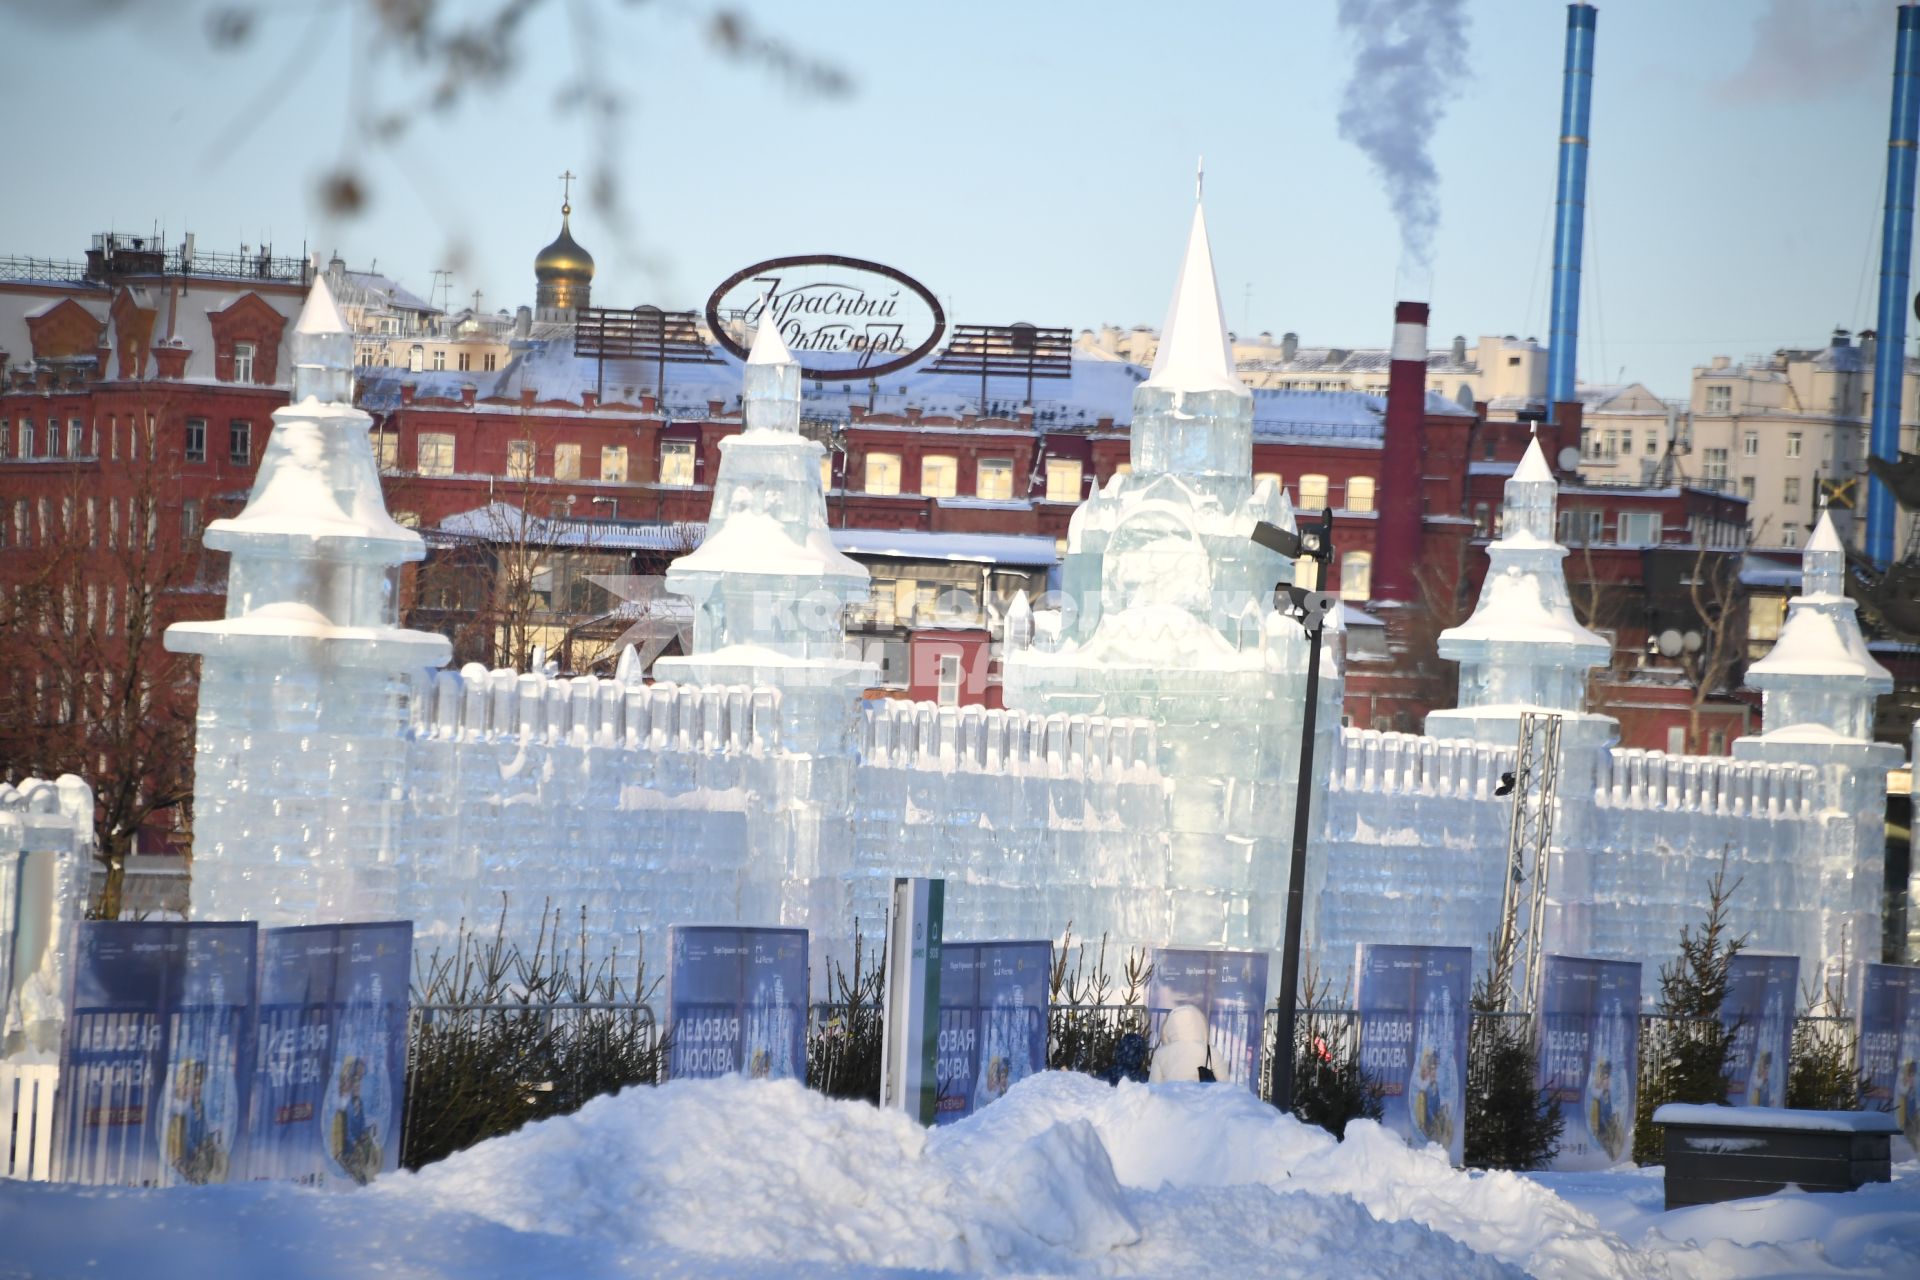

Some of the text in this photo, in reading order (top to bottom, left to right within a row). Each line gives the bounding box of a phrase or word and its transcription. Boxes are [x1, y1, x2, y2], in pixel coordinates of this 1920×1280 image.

[743, 278, 900, 328] Красный
[779, 318, 905, 369] Октябрь
[678, 1018, 740, 1042] ЛЕДОВАЯ
[938, 1029, 976, 1052] ОВАЯ
[1361, 1021, 1413, 1042] ЛЕДОВАЯ
[680, 1048, 735, 1072] МОСКВА
[936, 1057, 971, 1080] СКВА
[1362, 1048, 1408, 1069] МОСКВА
